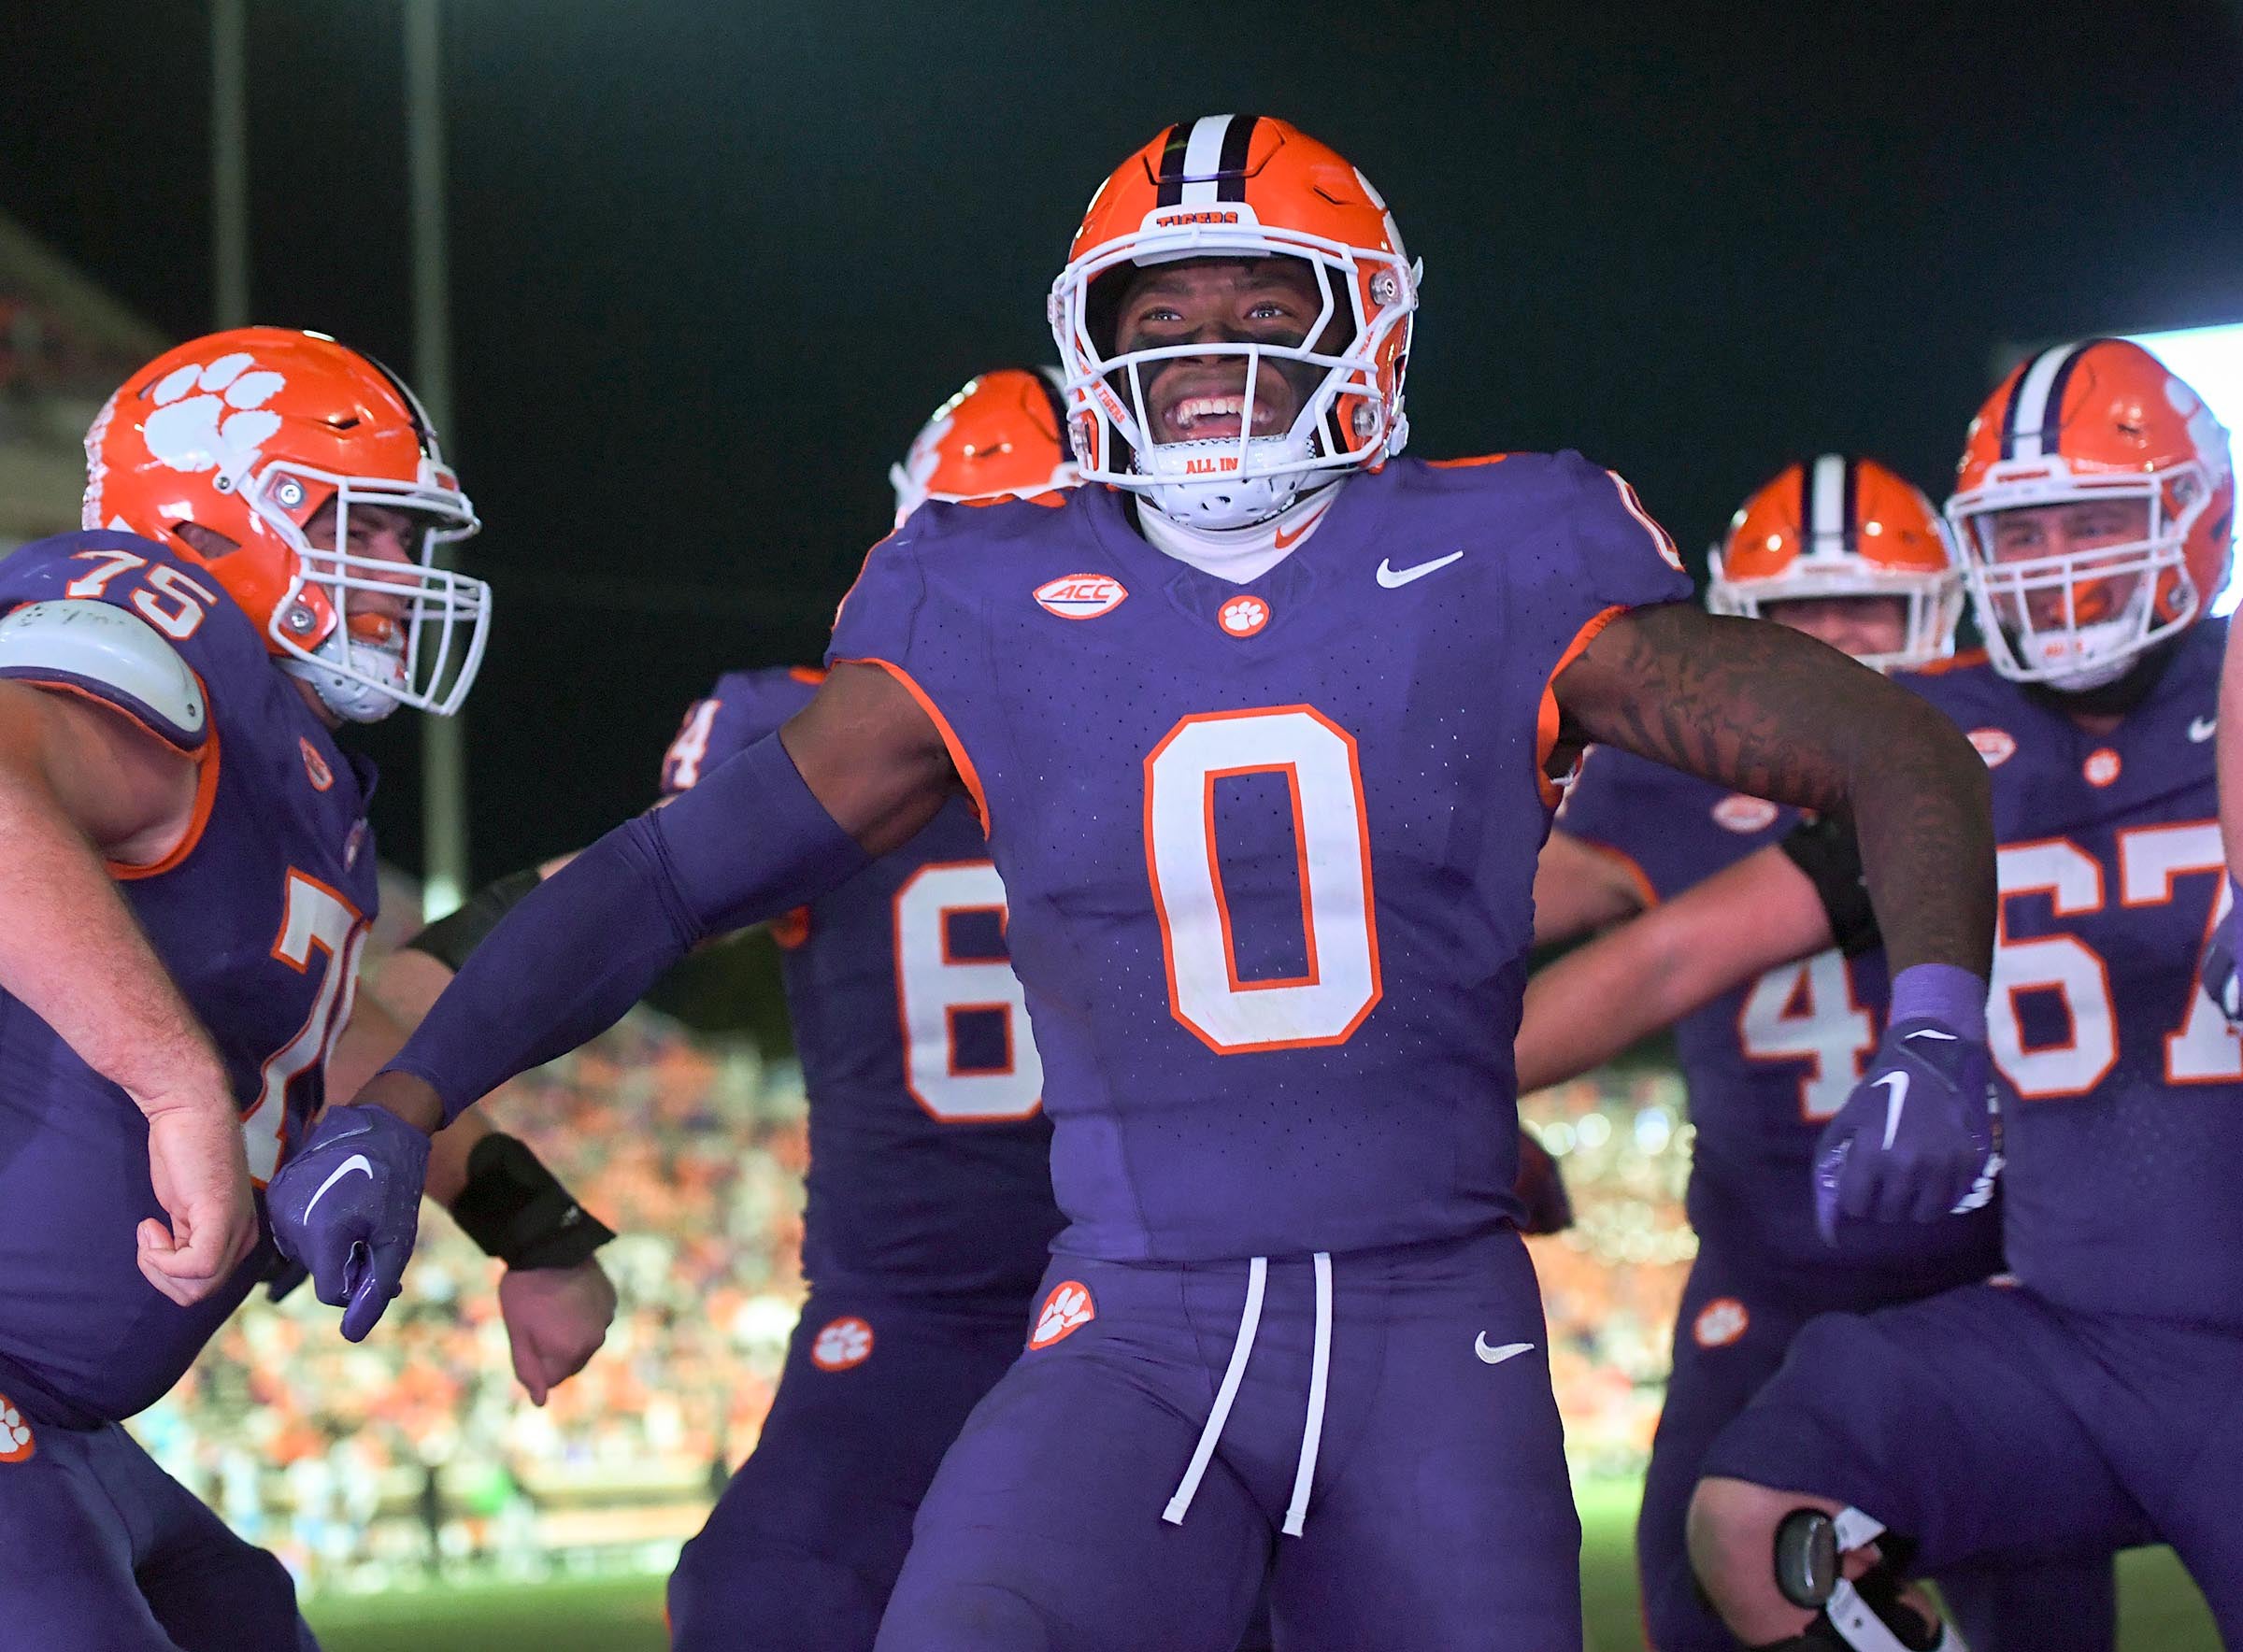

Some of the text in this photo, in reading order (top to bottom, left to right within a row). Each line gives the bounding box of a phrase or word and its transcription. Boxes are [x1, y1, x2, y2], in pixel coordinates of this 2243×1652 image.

[1156, 211, 1239, 228] TIGERS
[1098, 388, 1126, 424] TIGERS
[1186, 457, 1239, 475] ALL IN
[64, 549, 219, 641] 75
[1047, 584, 1117, 599] ACC
[1143, 704, 1383, 1056] 0
[892, 858, 1045, 1124] 6
[1985, 818, 2243, 1101] 67
